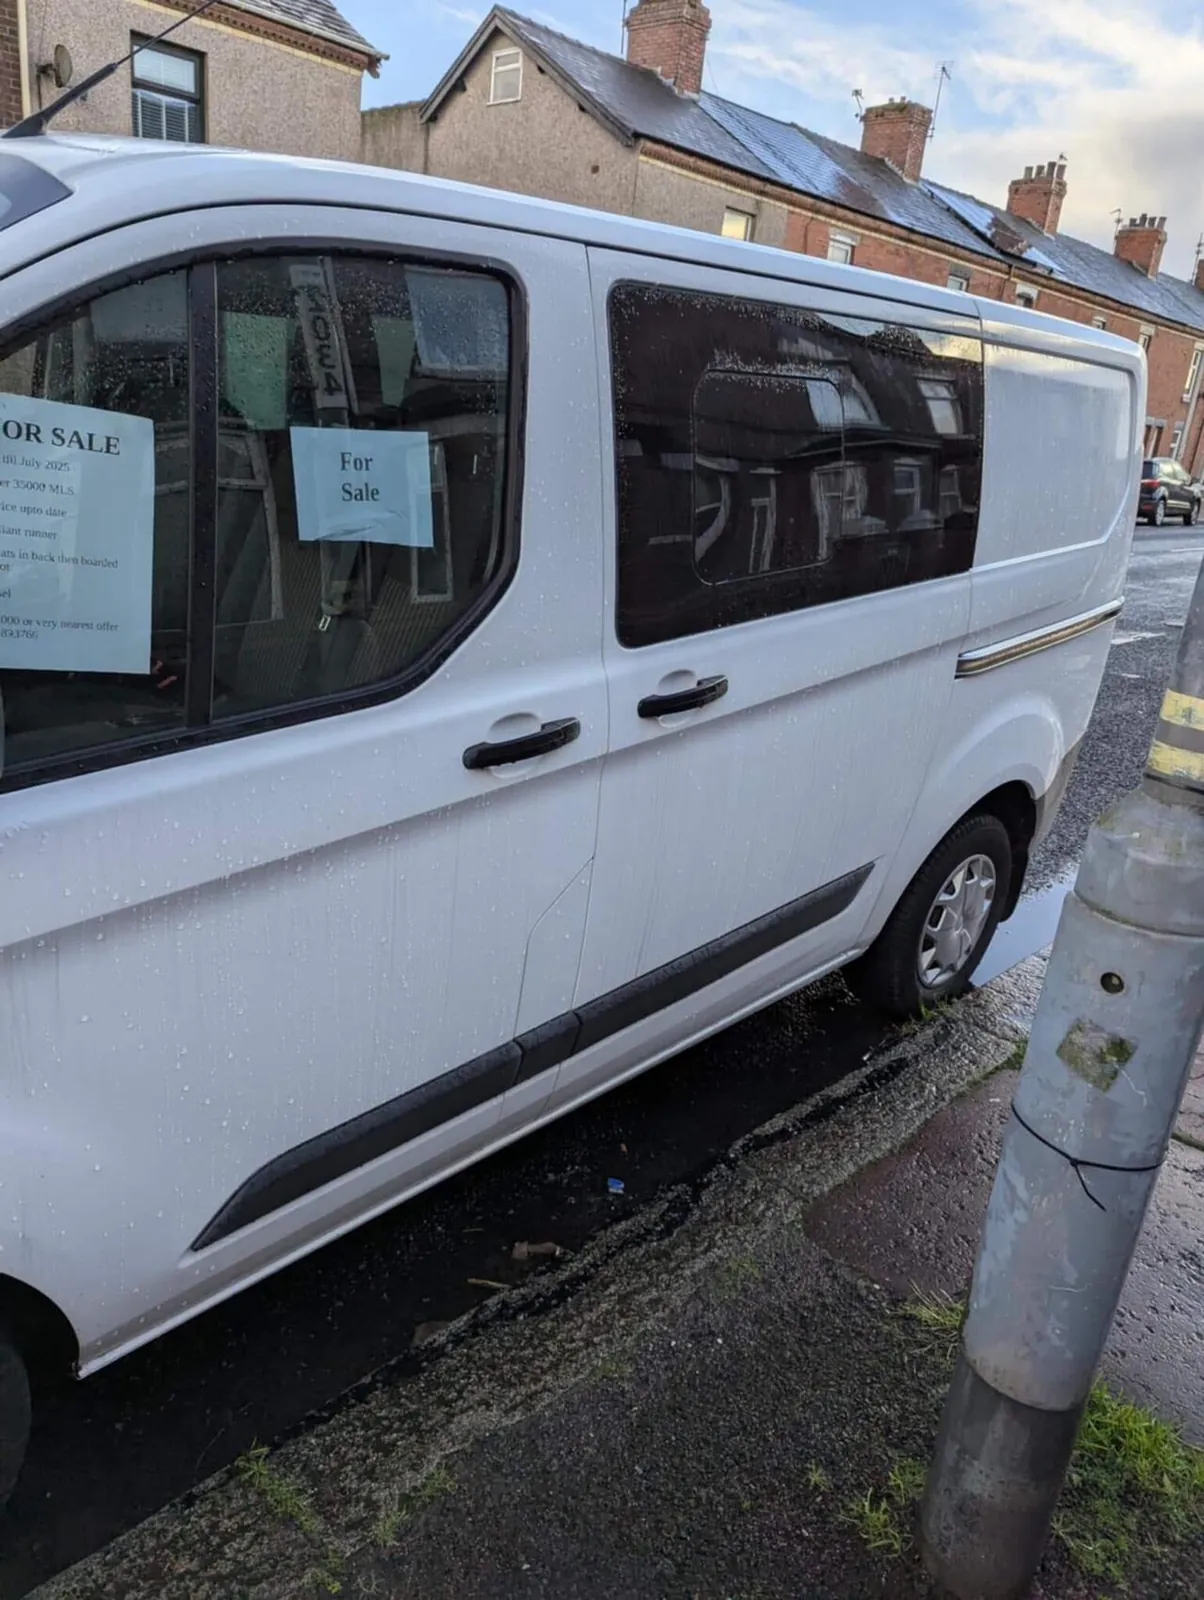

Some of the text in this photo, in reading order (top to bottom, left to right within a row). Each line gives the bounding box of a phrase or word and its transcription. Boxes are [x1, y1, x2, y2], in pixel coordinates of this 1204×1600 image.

[0, 419, 121, 456] OR SALE
[20, 456, 41, 470] July
[45, 459, 71, 472] 2025
[340, 452, 373, 472] For
[341, 482, 380, 502] Sale
[20, 504, 43, 517] upto
[45, 506, 67, 518] date
[24, 527, 58, 541] runner
[18, 548, 29, 560] in
[31, 550, 55, 563] back
[22, 618, 33, 627] or
[36, 619, 57, 631] very
[60, 620, 93, 631] nearest
[96, 621, 119, 632] offer
